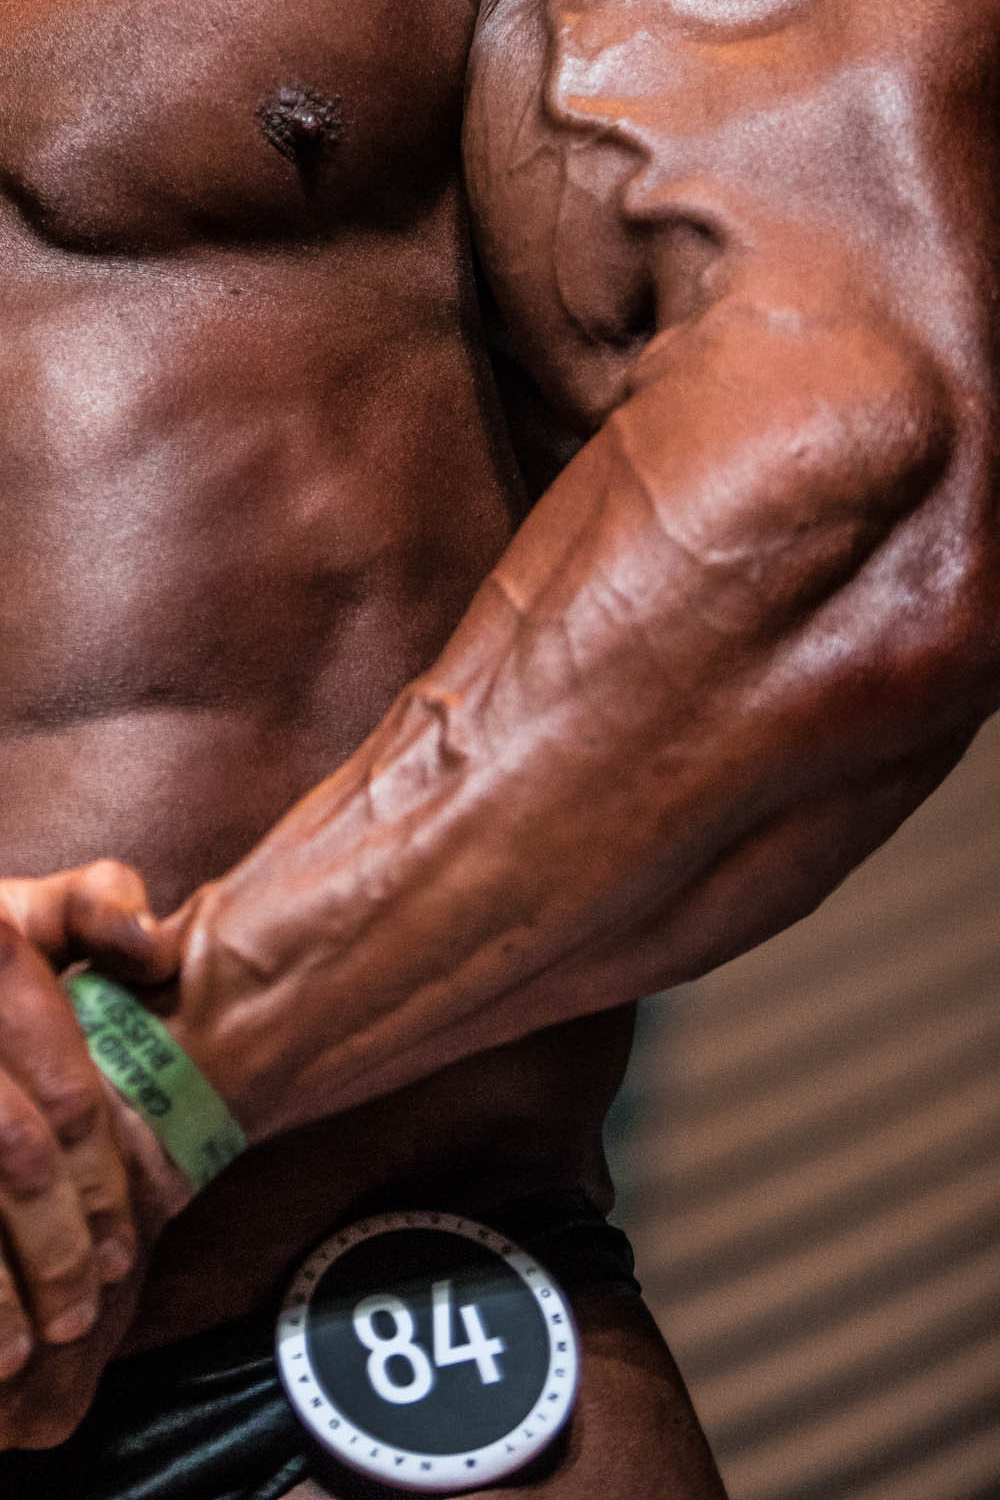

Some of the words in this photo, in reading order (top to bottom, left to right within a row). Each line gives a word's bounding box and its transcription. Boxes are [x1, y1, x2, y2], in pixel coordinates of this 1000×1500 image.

[290, 1351, 432, 1471] NATIONAL
[504, 1266, 569, 1453] COMMUNITY
[353, 1279, 504, 1404] 84
